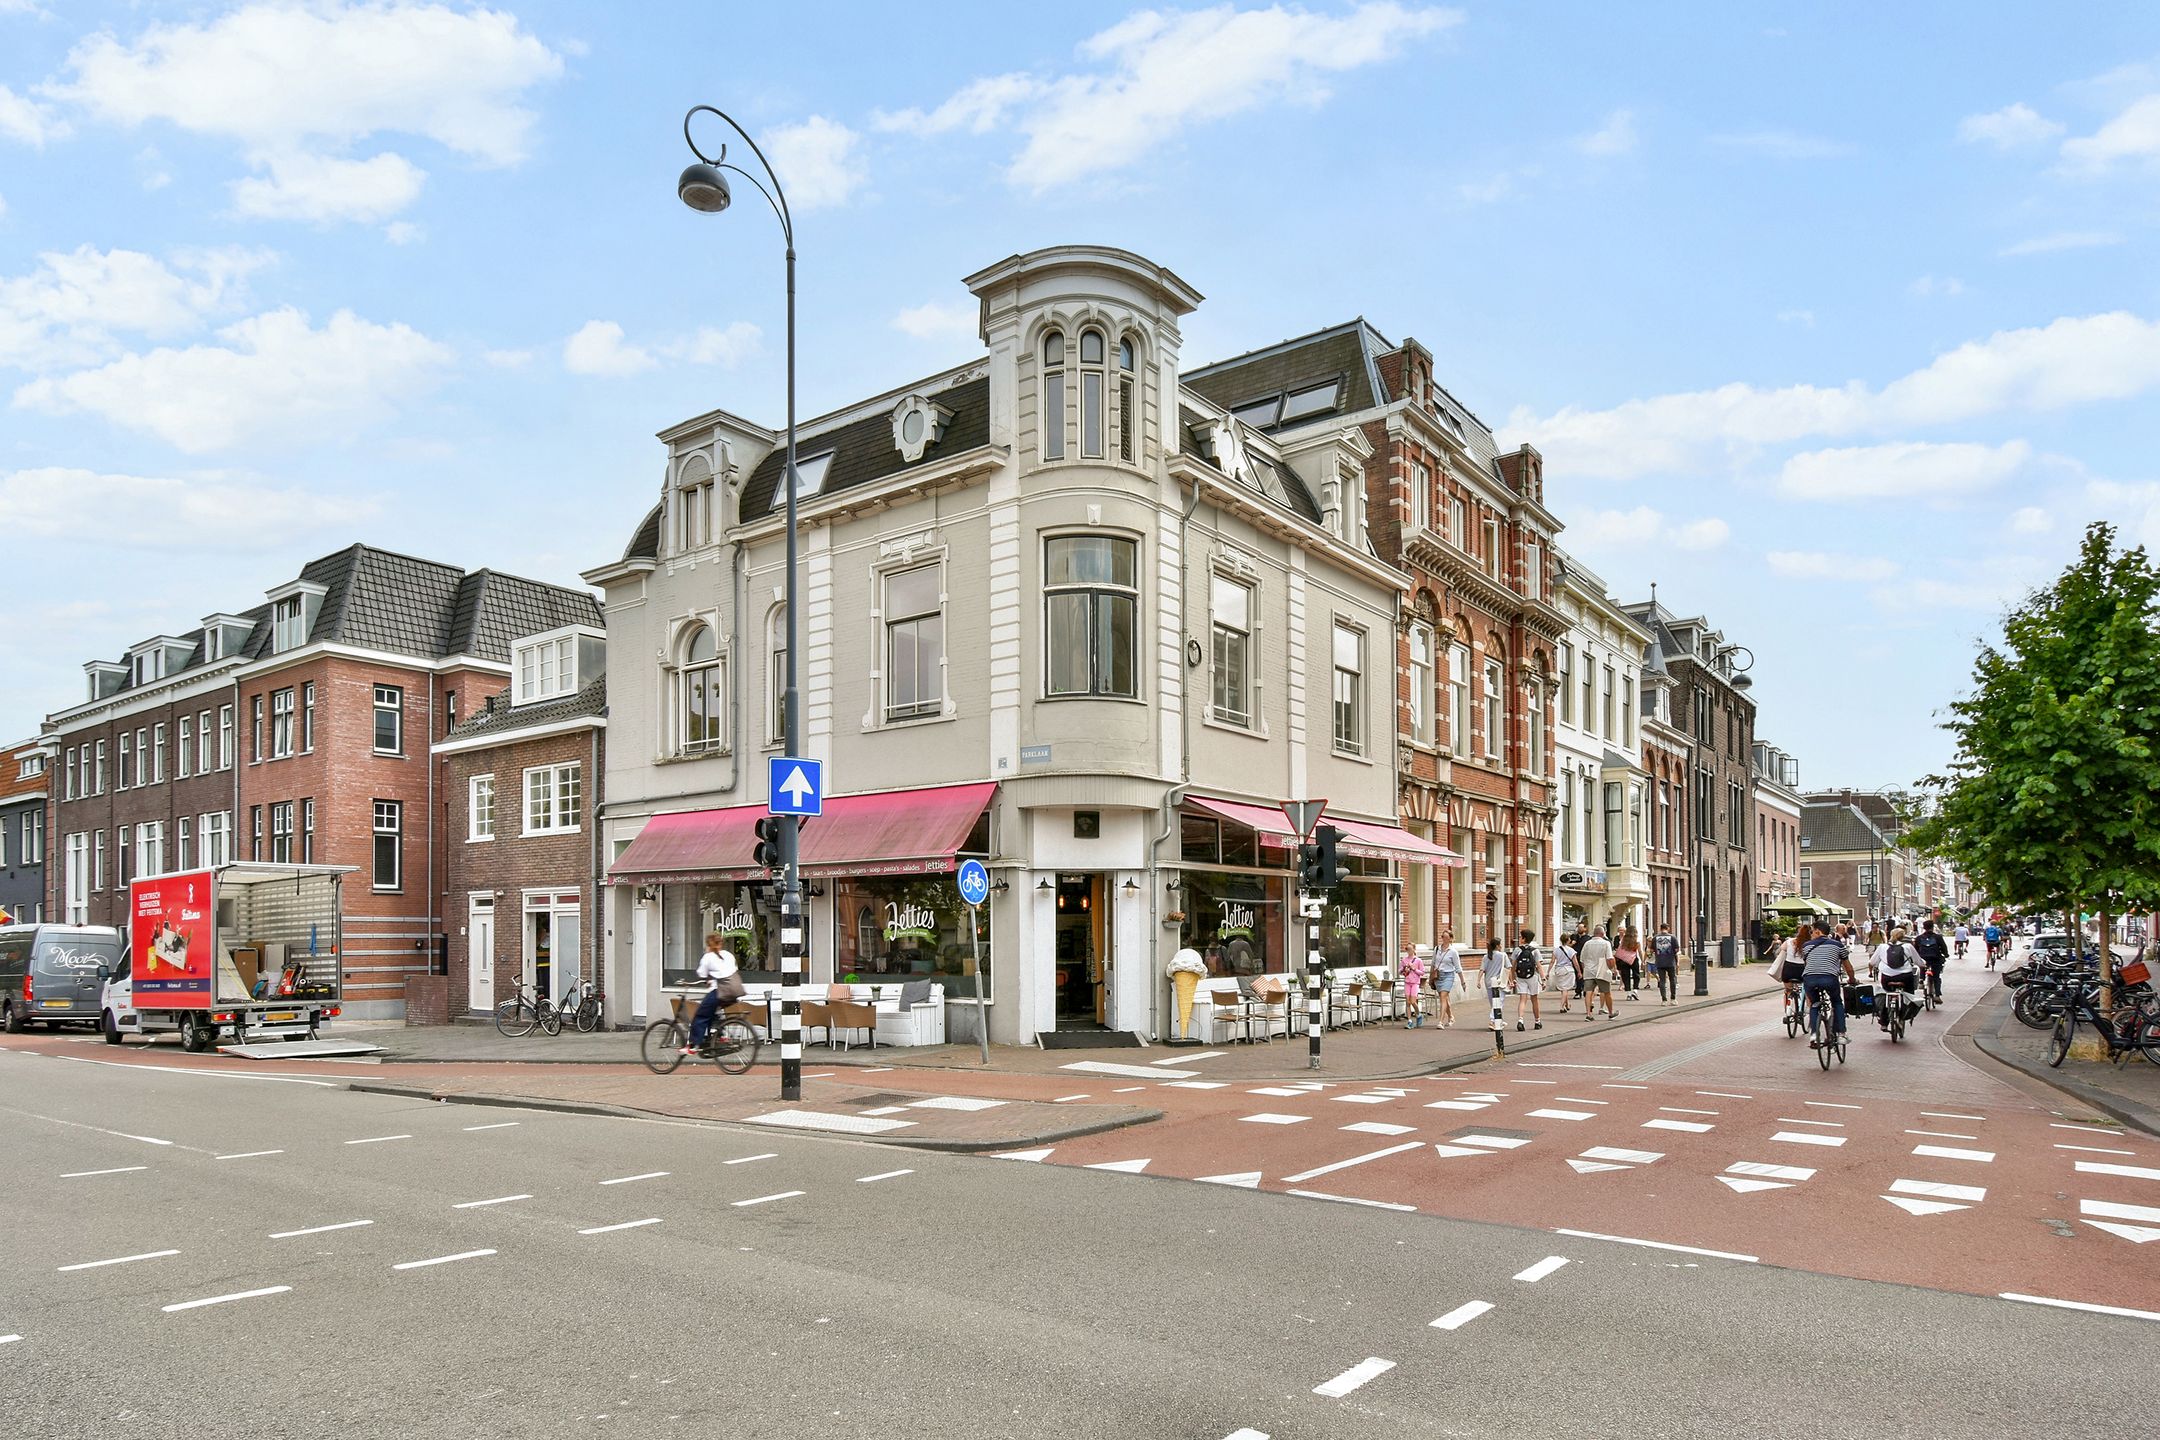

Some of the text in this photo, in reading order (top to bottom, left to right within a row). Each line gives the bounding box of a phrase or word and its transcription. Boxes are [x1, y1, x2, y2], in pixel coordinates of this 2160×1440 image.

[746, 868, 765, 879] jetties
[849, 867, 867, 875] burgers
[883, 865, 900, 873] pasta's
[924, 860, 948, 872] jetties
[713, 906, 753, 938] Jetties
[884, 901, 935, 941] Jetties
[1218, 900, 1254, 940] Jetties
[1333, 905, 1360, 939] Jetties
